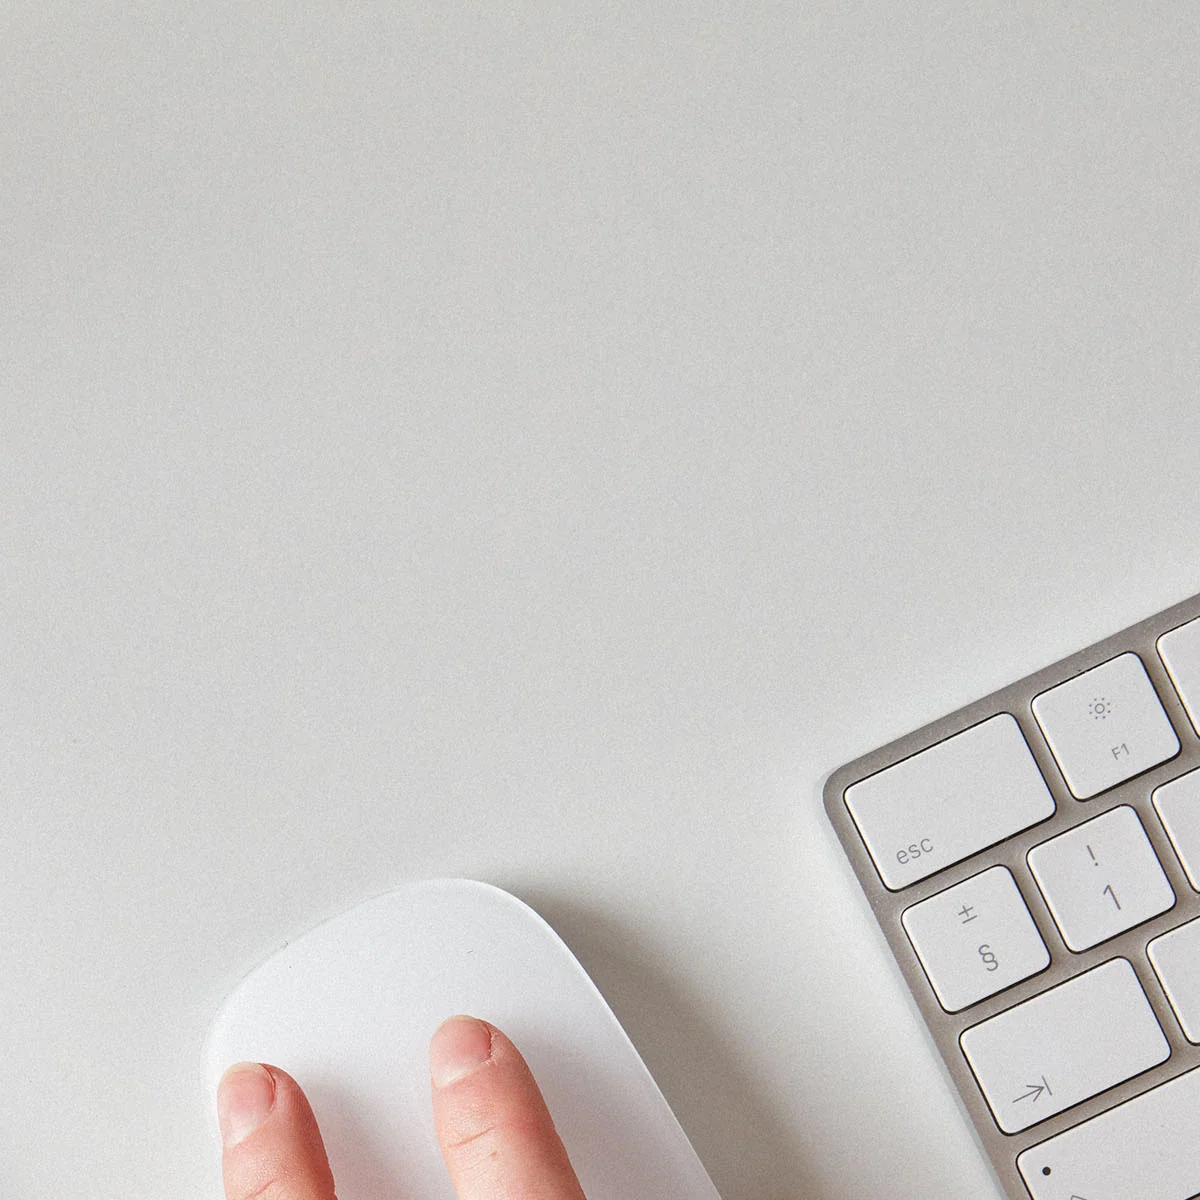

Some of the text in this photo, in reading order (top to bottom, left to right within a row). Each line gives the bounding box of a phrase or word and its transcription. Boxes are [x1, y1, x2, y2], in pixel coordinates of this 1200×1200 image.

[1111, 743, 1131, 761] F1
[895, 837, 934, 865] esc
[1102, 883, 1122, 911] 1
